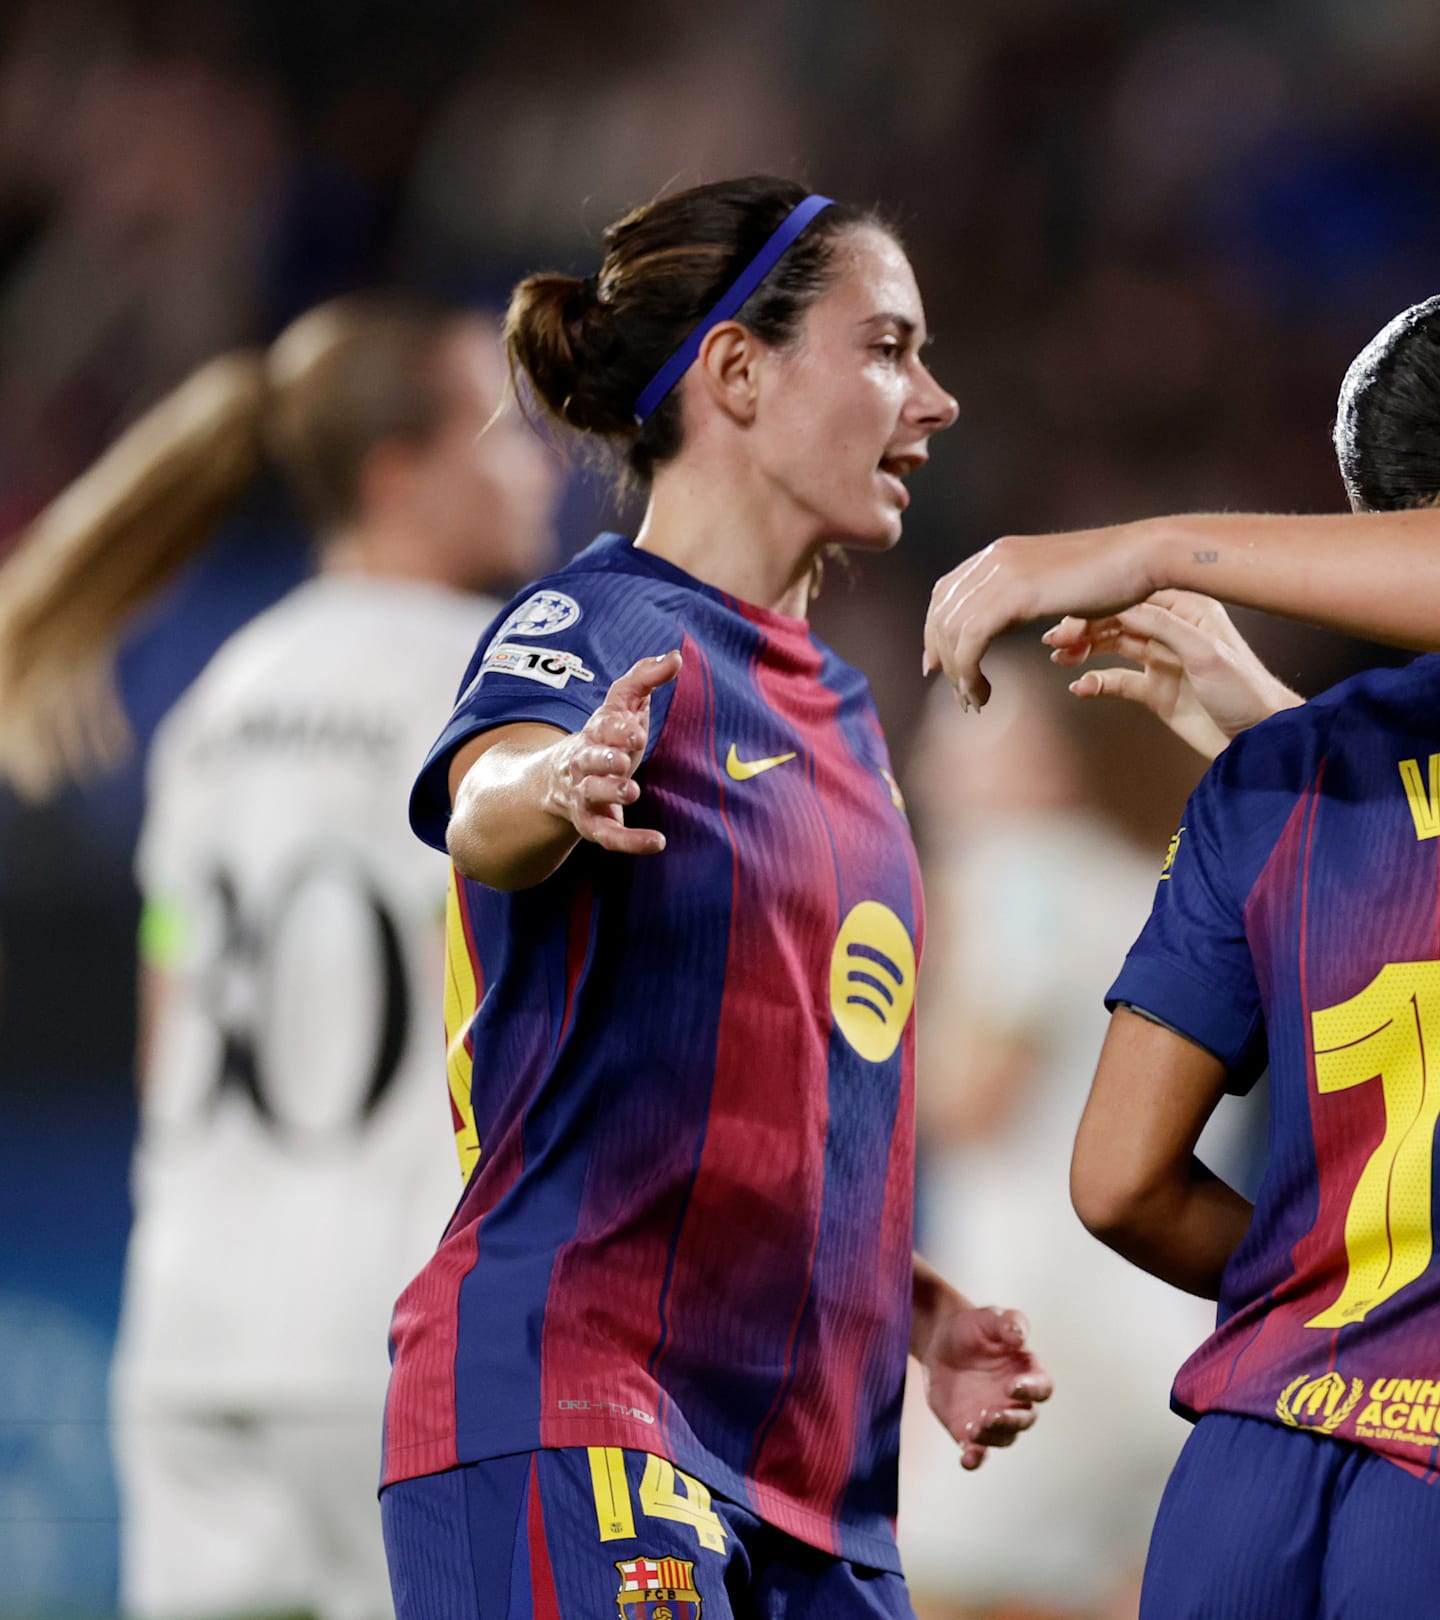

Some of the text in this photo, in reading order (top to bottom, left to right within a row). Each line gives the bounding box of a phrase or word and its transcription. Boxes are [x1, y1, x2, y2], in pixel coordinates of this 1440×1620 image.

[1355, 1425, 1375, 1438] The
[586, 1446, 729, 1556] 14
[643, 1589, 677, 1601] FCB
